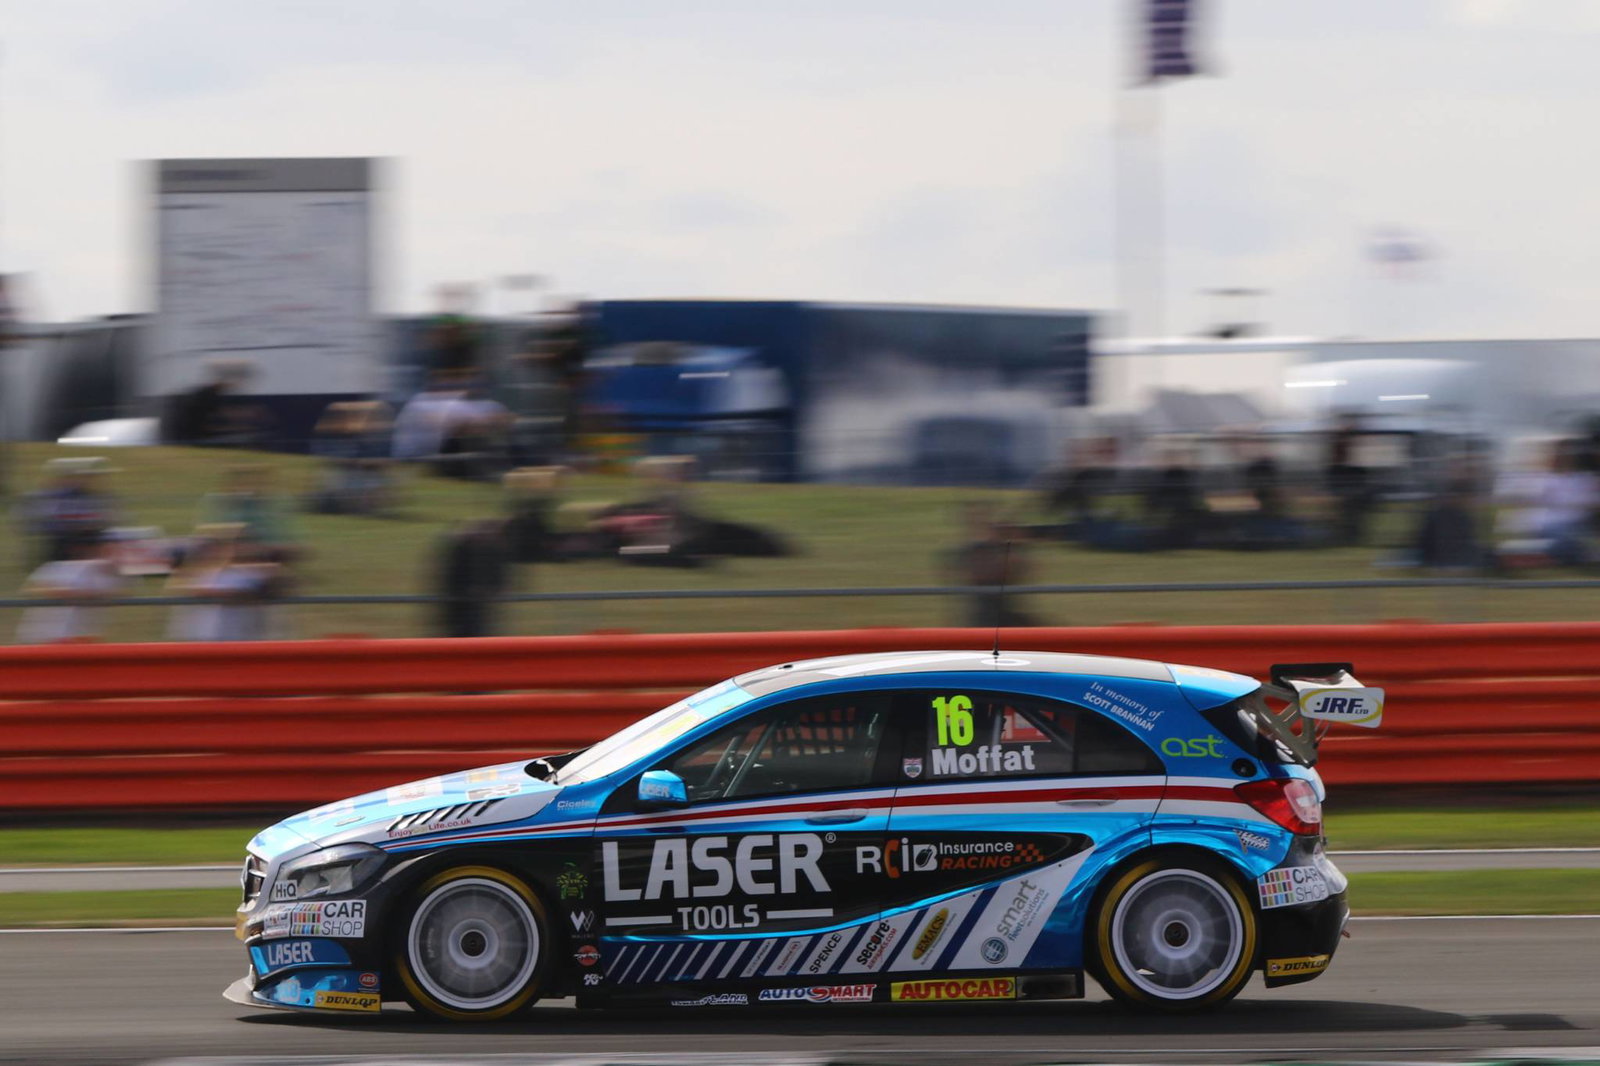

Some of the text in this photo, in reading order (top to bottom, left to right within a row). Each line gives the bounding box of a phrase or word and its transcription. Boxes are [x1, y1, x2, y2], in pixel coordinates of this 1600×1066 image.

[1083, 692, 1155, 731] SCOTT BRANNAN
[1090, 681, 1165, 722] In memory of
[932, 695, 974, 746] 16
[932, 745, 1036, 776] Moffat
[940, 842, 1014, 855] Insurance
[941, 855, 1014, 869] RACING
[276, 883, 296, 898] HiQ
[324, 902, 364, 919] CAR
[677, 903, 761, 930] TOOLS
[996, 879, 1037, 936] smart
[322, 921, 363, 936] SHOP
[268, 941, 315, 965] LASER
[809, 933, 842, 974] SPENCE
[326, 996, 378, 1007] DUNLOP
[899, 980, 1011, 999] AUTOCAR
